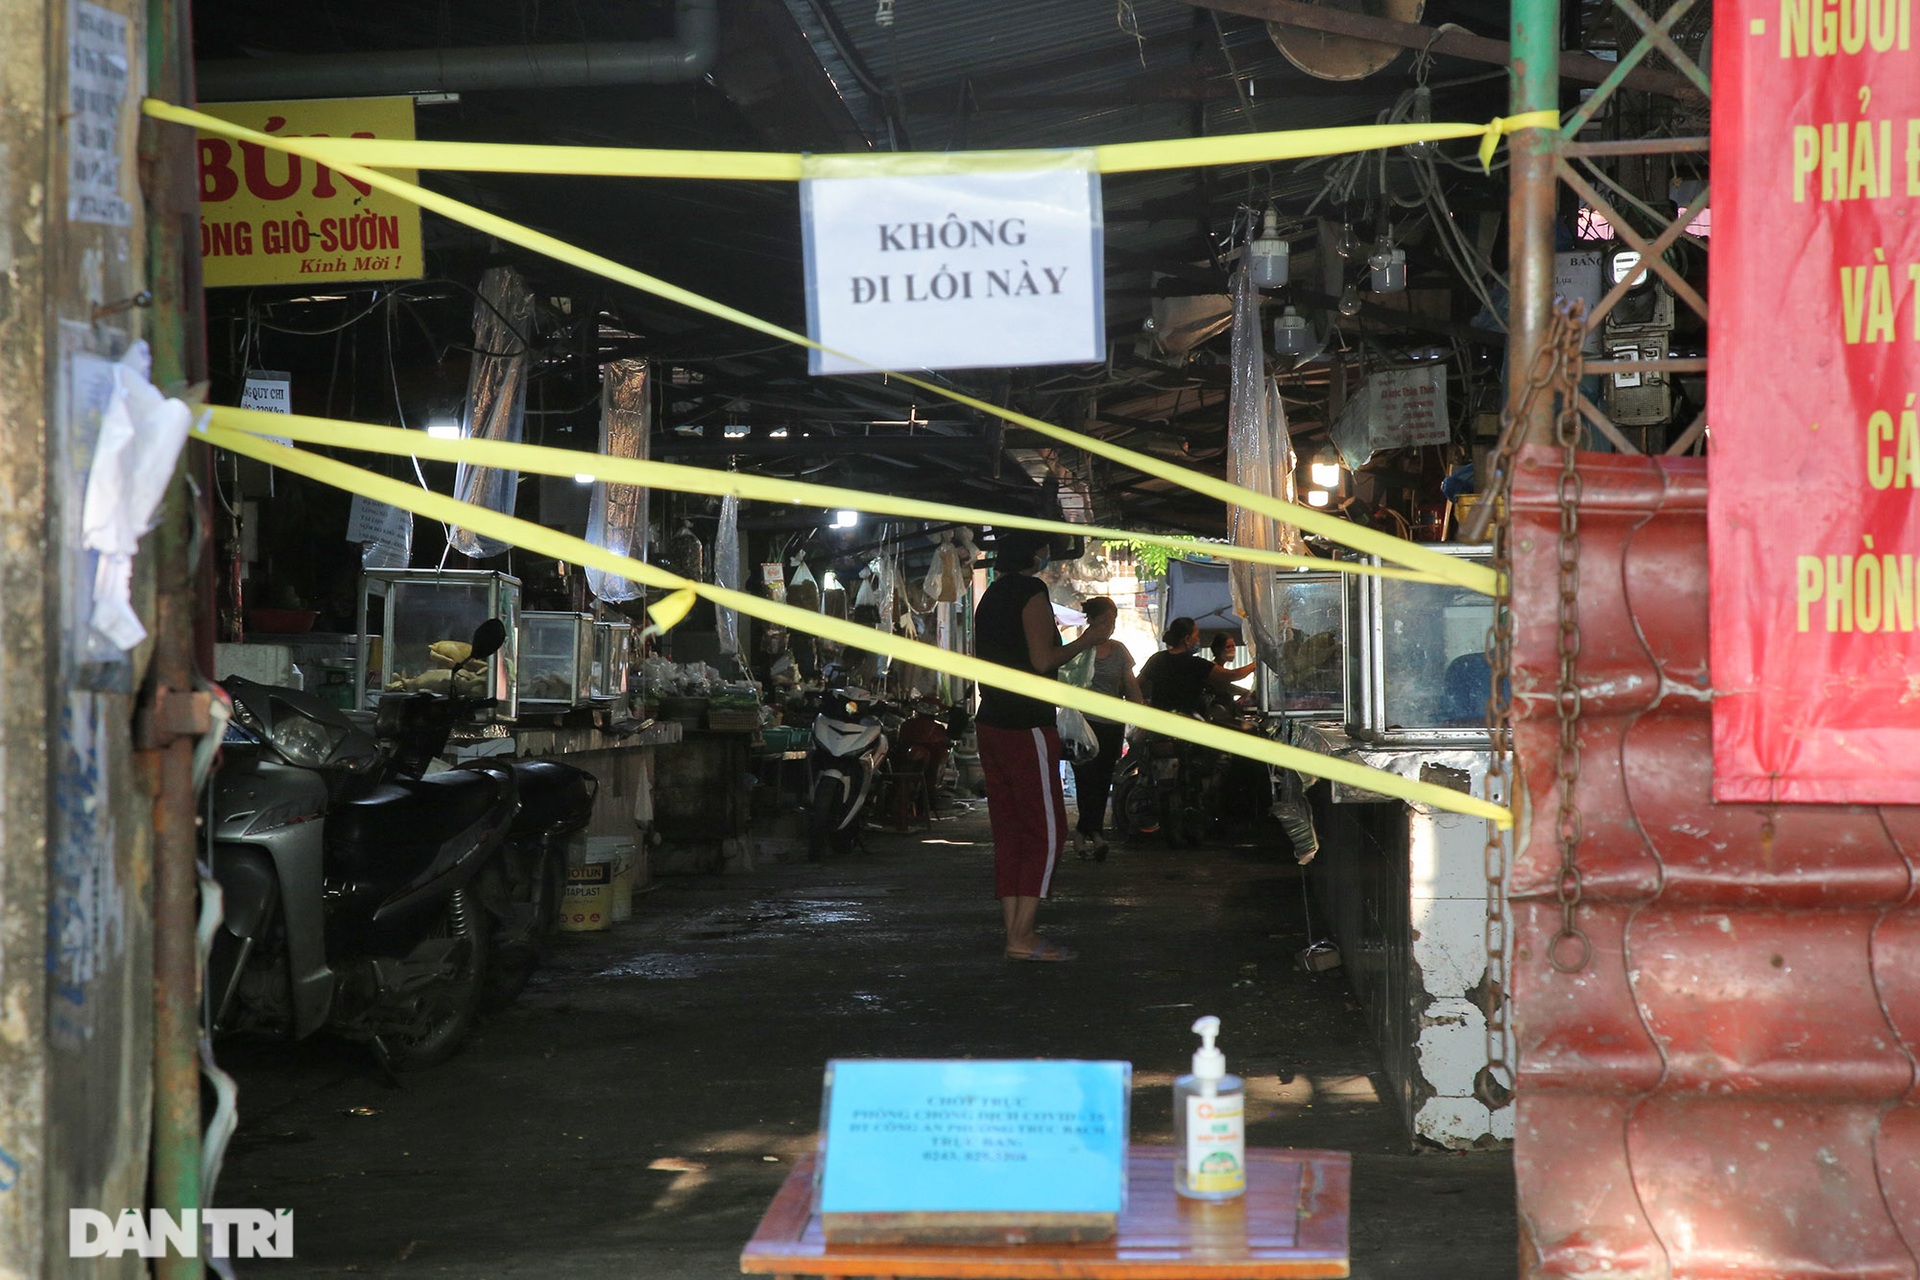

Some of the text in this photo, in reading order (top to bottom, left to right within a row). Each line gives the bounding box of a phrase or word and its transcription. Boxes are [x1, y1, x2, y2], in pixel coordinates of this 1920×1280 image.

[1793, 85, 1892, 203] PHẢI
[262, 211, 310, 255] GIÒ
[320, 208, 400, 252] SƯỜN
[878, 212, 1027, 251] KHÔNG
[299, 257, 346, 274] Kính
[352, 256, 390, 271] Mời
[849, 260, 1069, 304] ĐI LỐI NÀY
[1841, 247, 1896, 344] VÀ
[270, 388, 285, 399] CHI
[1797, 535, 1920, 634] PHÒN
